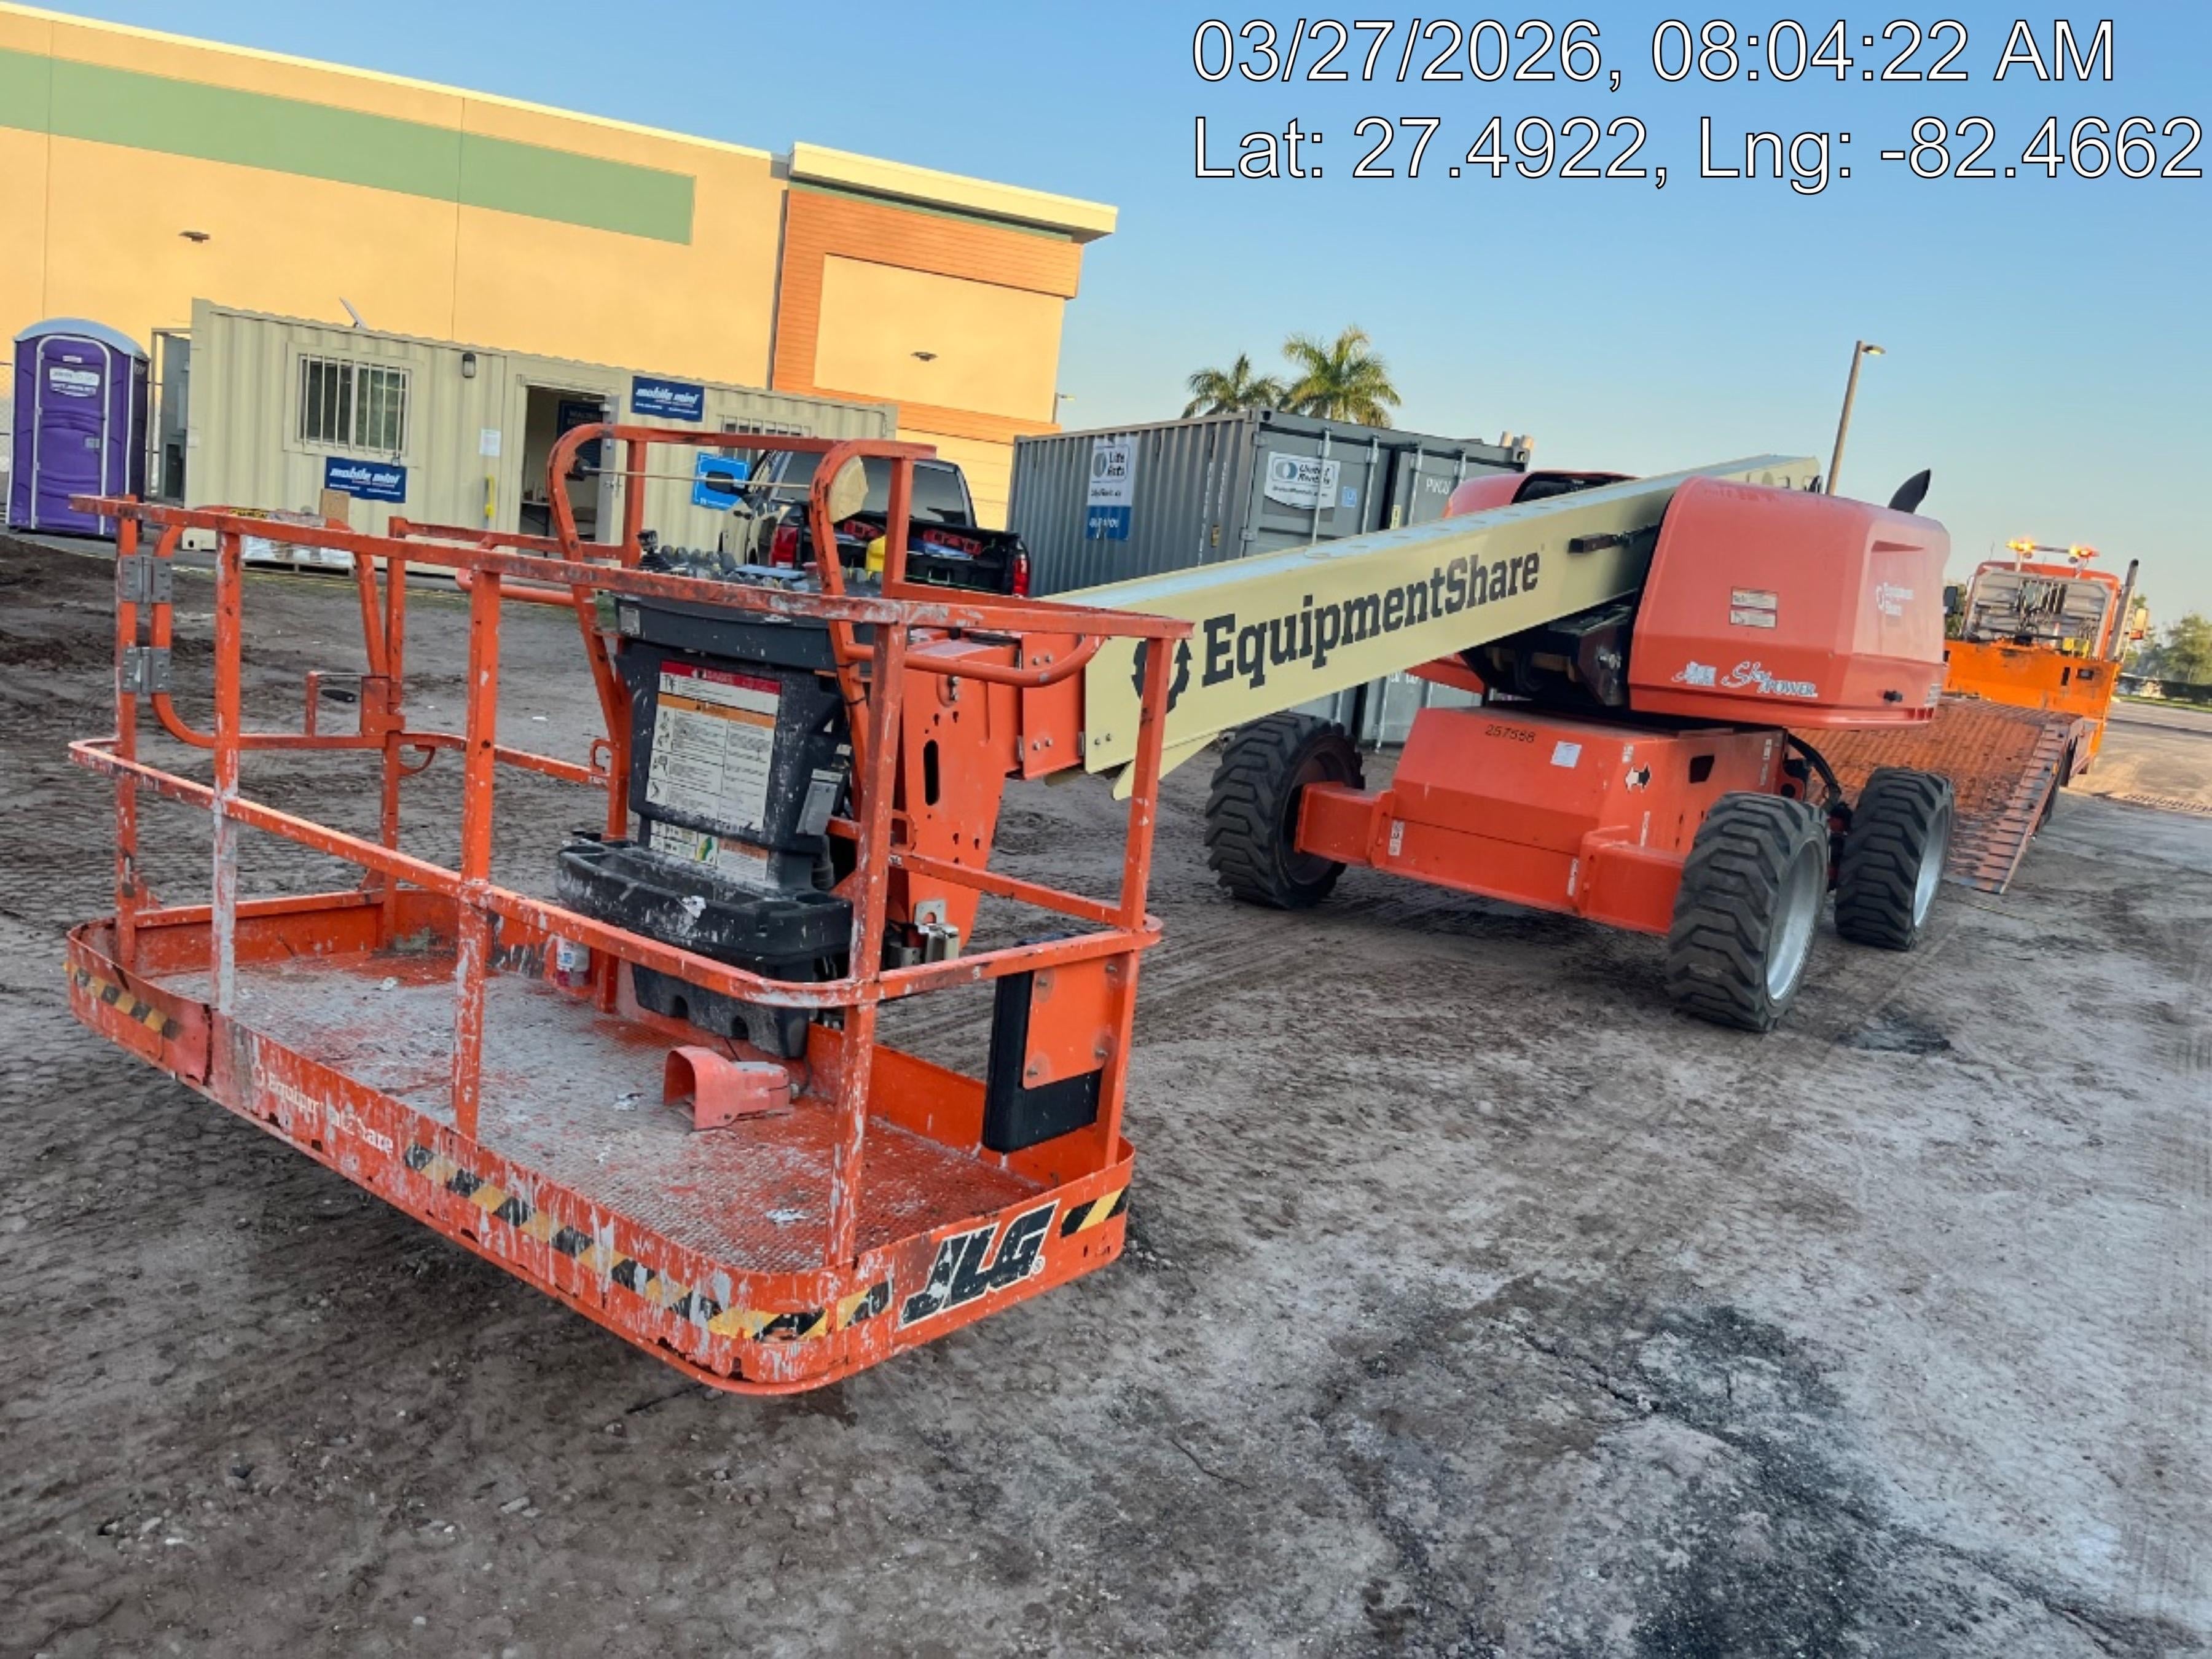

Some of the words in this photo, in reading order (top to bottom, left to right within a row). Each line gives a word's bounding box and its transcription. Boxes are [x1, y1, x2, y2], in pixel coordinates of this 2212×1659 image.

[635, 387, 673, 400] mobile
[329, 466, 371, 482] mobile
[1202, 552, 1540, 689] EquipmentShare
[895, 1199, 1060, 1330] JLG
